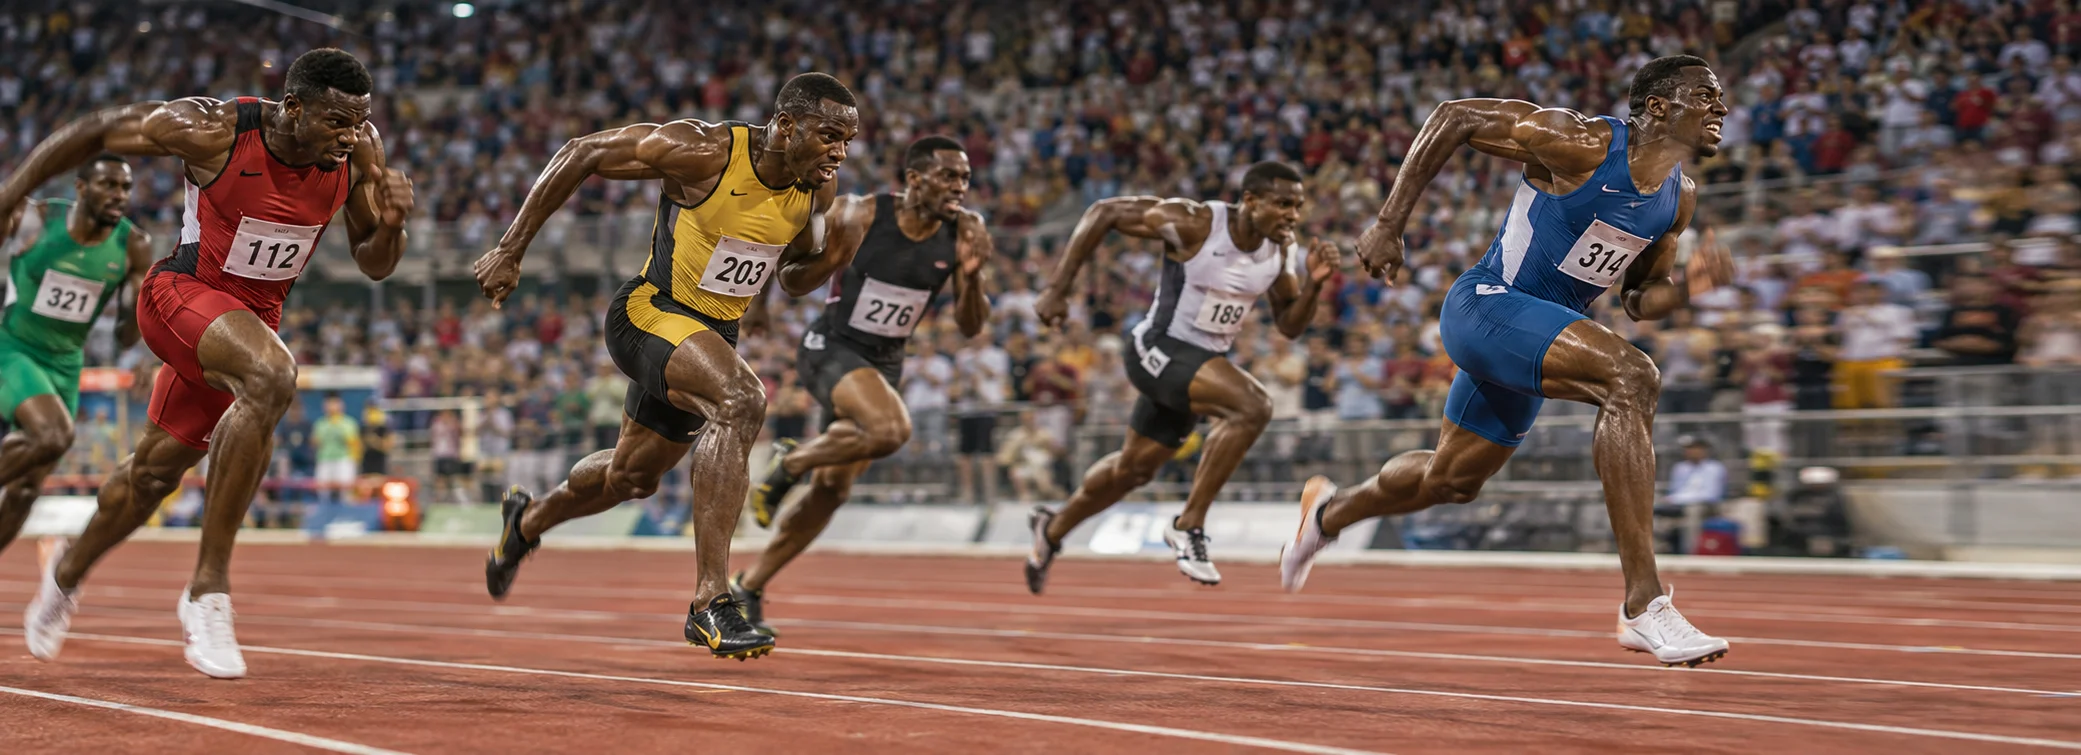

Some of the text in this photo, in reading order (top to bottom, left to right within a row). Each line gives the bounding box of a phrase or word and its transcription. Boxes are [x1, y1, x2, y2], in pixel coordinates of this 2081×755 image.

[248, 240, 299, 268] 112
[1579, 243, 1628, 276] 314
[715, 257, 766, 285] 203
[47, 288, 88, 312] 321
[865, 299, 913, 326] 276
[1211, 304, 1244, 325] 189
